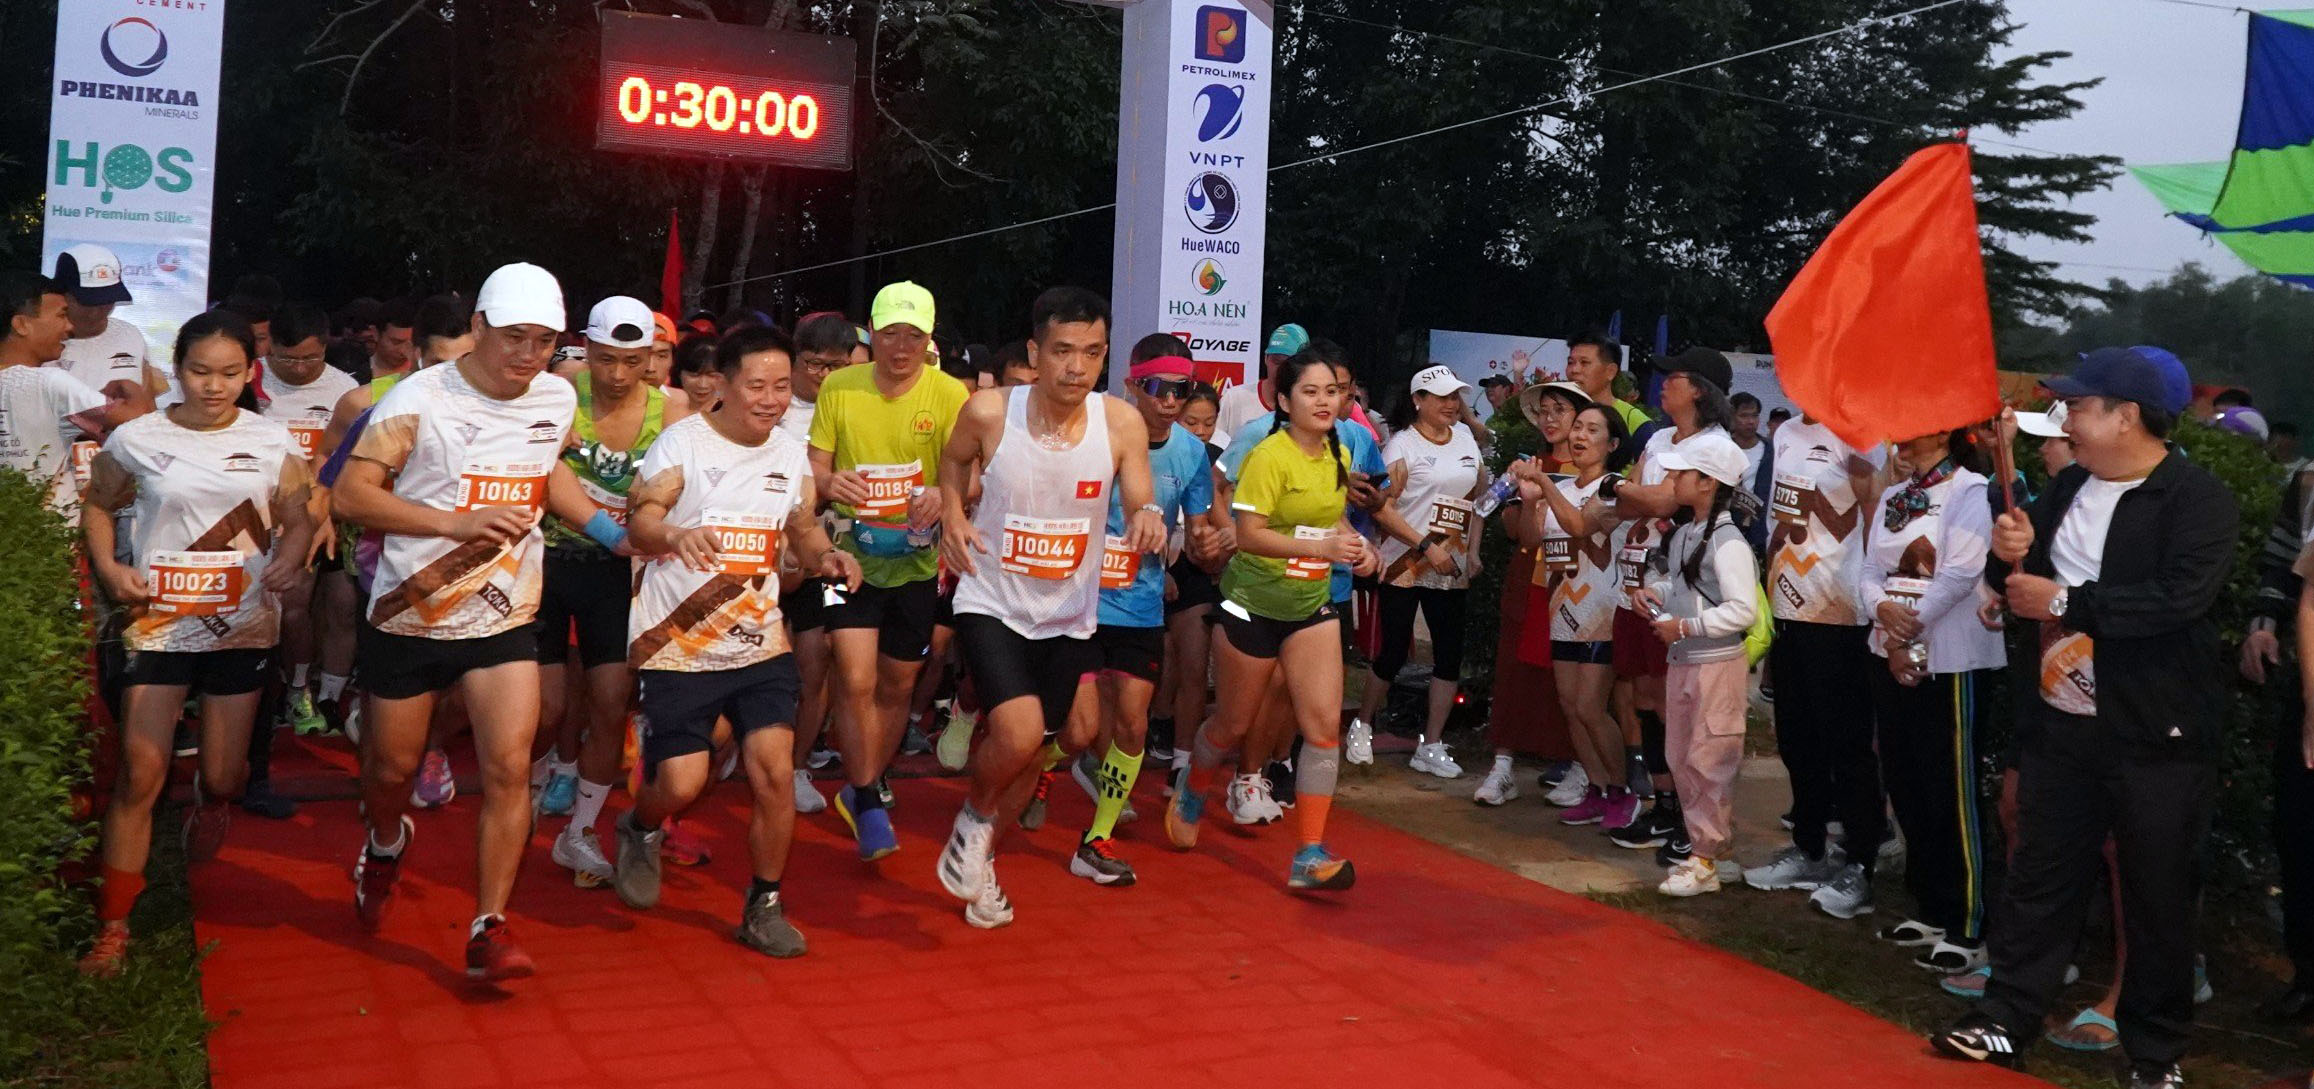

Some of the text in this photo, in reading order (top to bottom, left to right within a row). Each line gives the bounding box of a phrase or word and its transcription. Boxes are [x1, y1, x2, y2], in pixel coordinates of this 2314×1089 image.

[137, 0, 206, 11] CEMENT
[1182, 64, 1256, 81] PETROLIMEX
[60, 79, 199, 107] PHENIKAA
[145, 107, 199, 120] MINERALS
[619, 77, 818, 139] 0:30:00
[1189, 151, 1245, 168] VNPT
[52, 204, 81, 217] Hue
[85, 206, 150, 222] Premium
[1181, 236, 1240, 255] HueWACO
[1422, 368, 1451, 384] SPO
[478, 481, 532, 502] 10163
[867, 479, 914, 498] 10188
[1017, 535, 1076, 557] 10044
[163, 571, 227, 592] 10023
[1779, 576, 1802, 605] 10KM
[483, 586, 511, 615] 10KM
